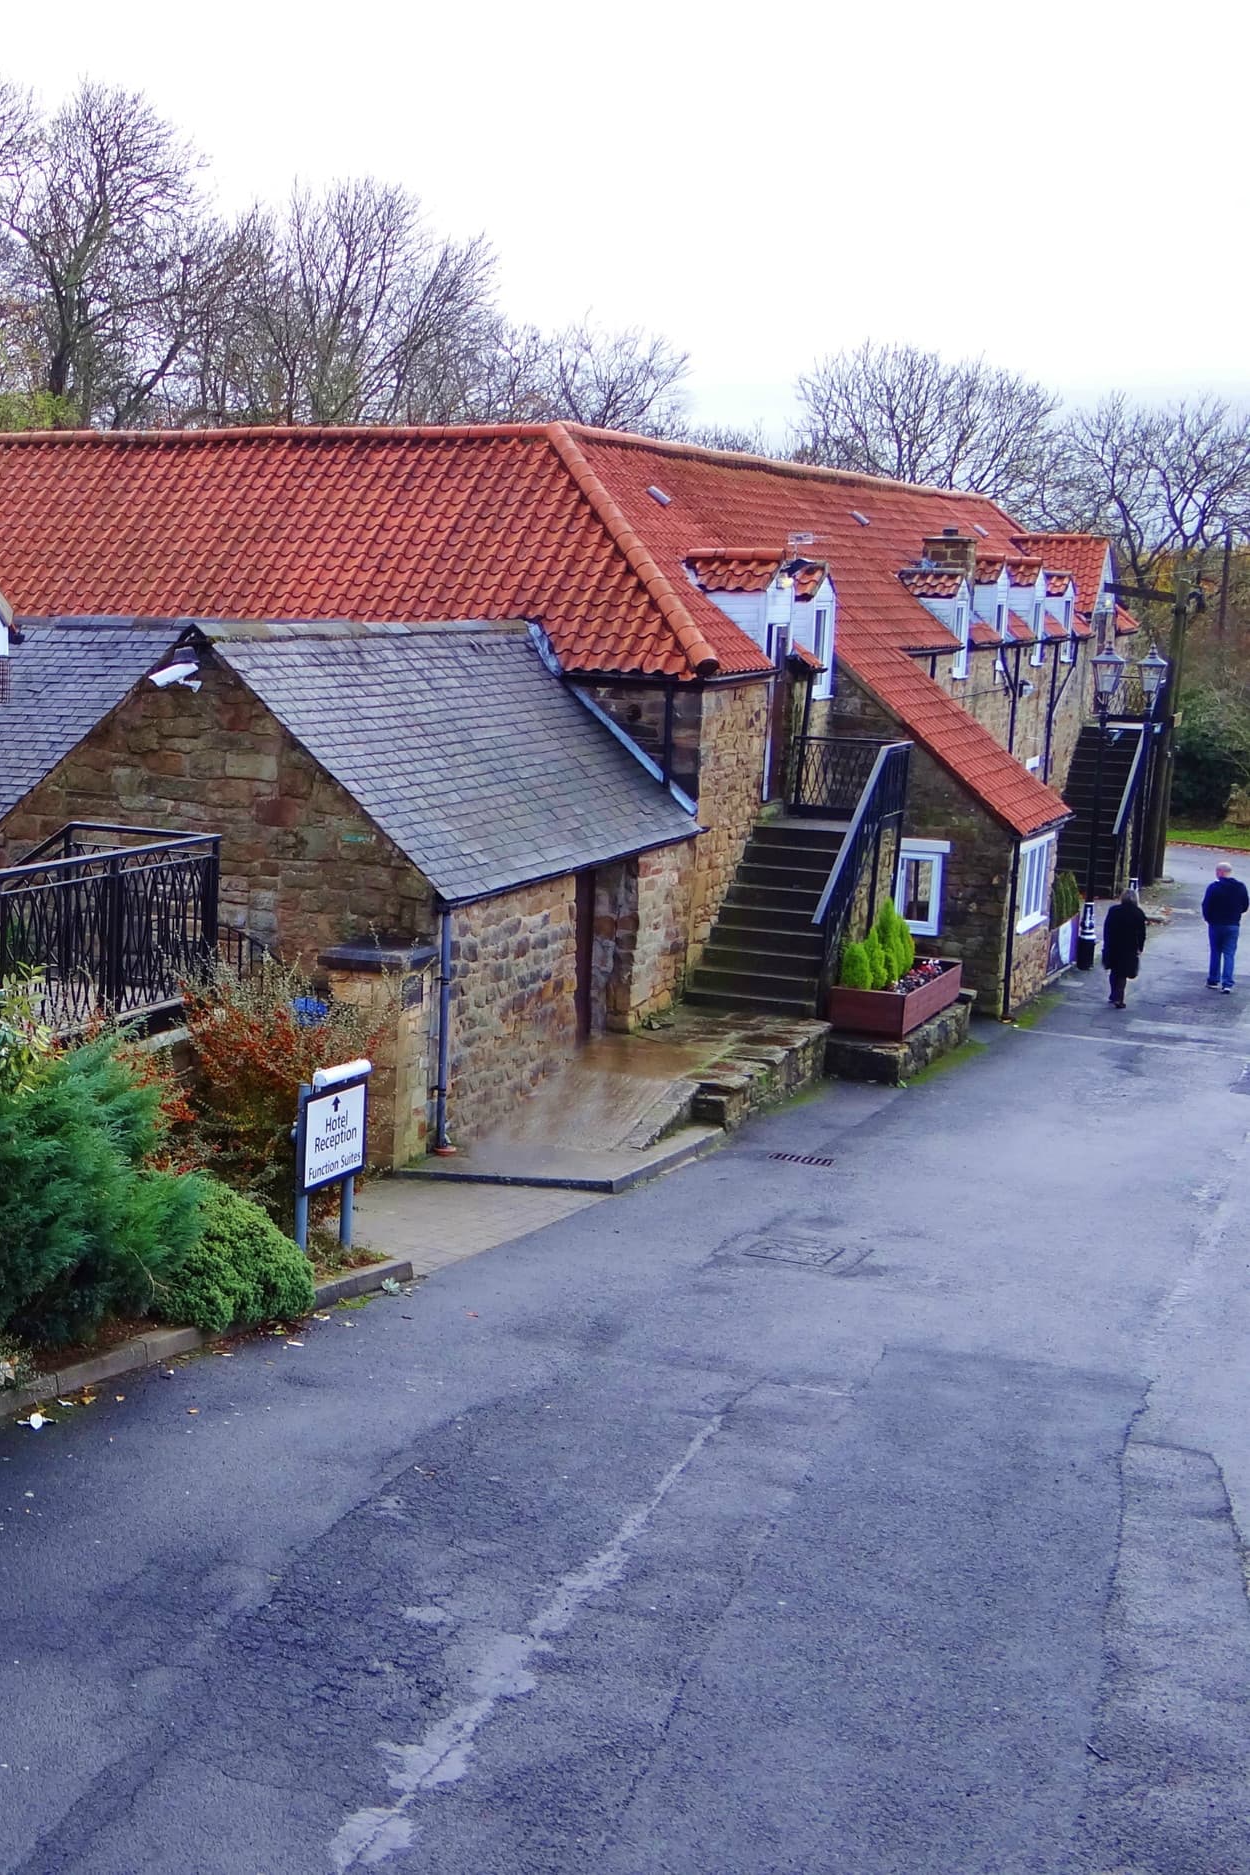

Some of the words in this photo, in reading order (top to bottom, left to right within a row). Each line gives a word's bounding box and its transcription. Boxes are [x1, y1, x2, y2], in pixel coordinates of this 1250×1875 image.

[325, 1110, 348, 1133] Hotel
[314, 1126, 357, 1153] Reception
[308, 1159, 339, 1180] Function
[341, 1151, 361, 1169] Suites
